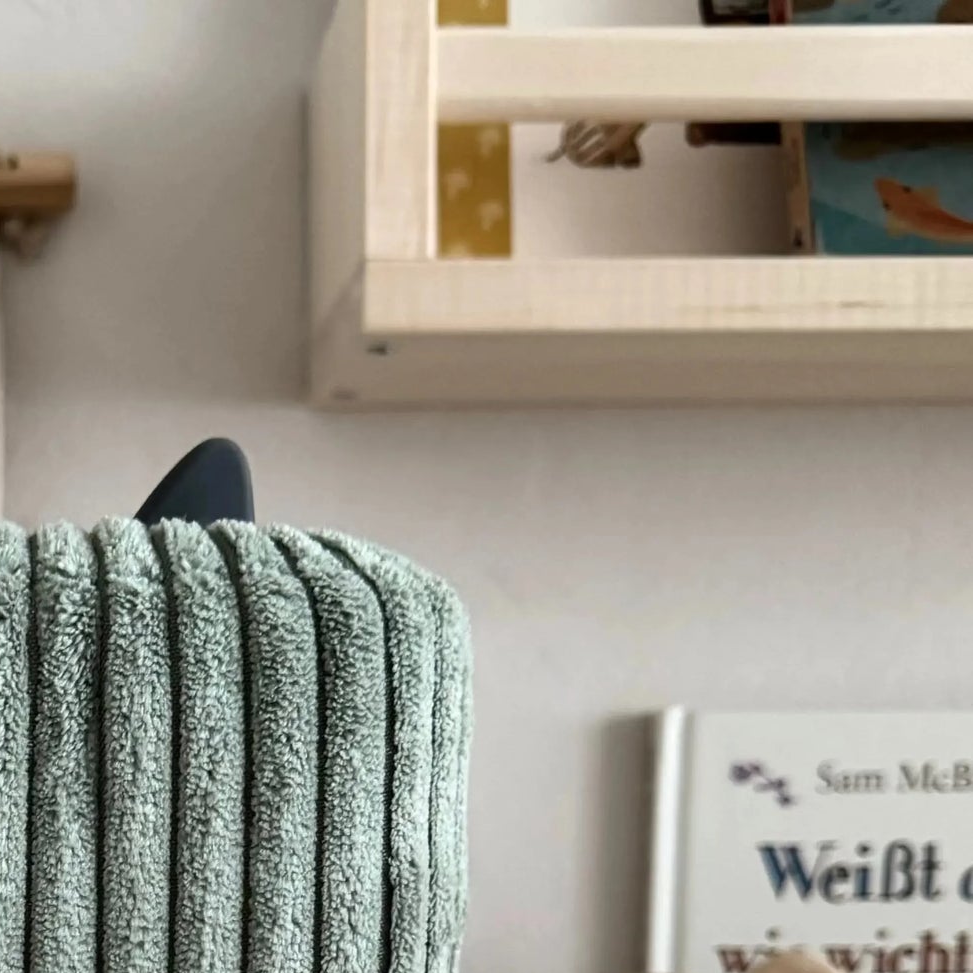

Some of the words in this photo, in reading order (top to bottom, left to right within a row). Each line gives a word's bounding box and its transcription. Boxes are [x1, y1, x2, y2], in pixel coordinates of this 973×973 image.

[815, 759, 886, 794] Sam
[896, 759, 973, 794] McB
[757, 839, 943, 904] Weißt
